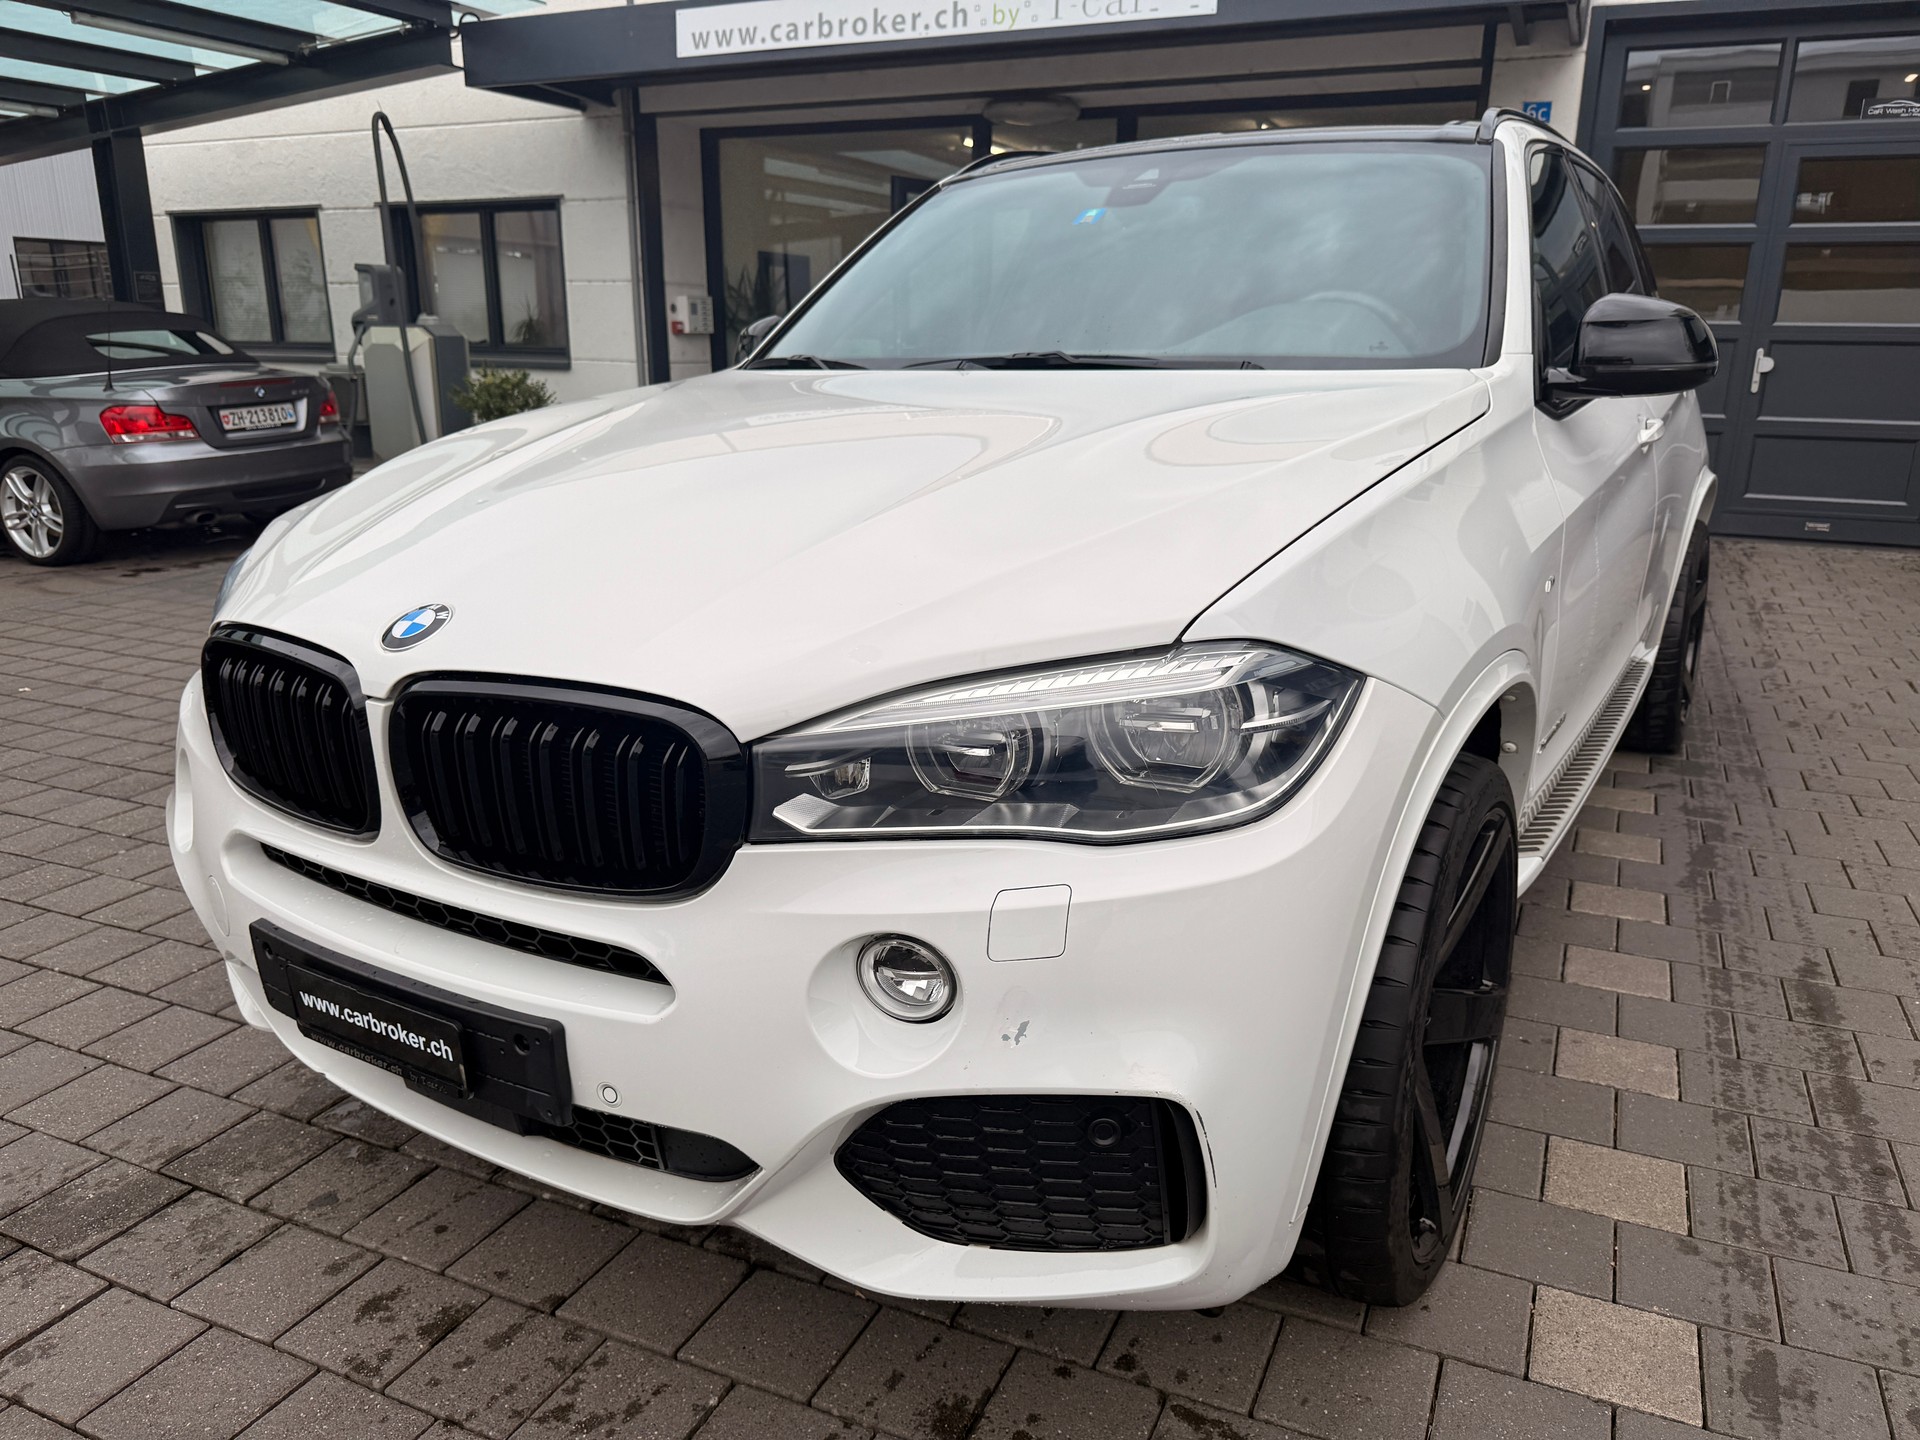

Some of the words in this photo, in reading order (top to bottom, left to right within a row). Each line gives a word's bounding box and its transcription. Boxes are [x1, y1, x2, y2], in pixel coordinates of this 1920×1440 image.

[692, 1, 967, 49] www.carbroker.ch
[993, 3, 1020, 29] by
[300, 991, 453, 1061] www.carbroker.ch
[311, 1033, 402, 1075] www.carbroker.ch
